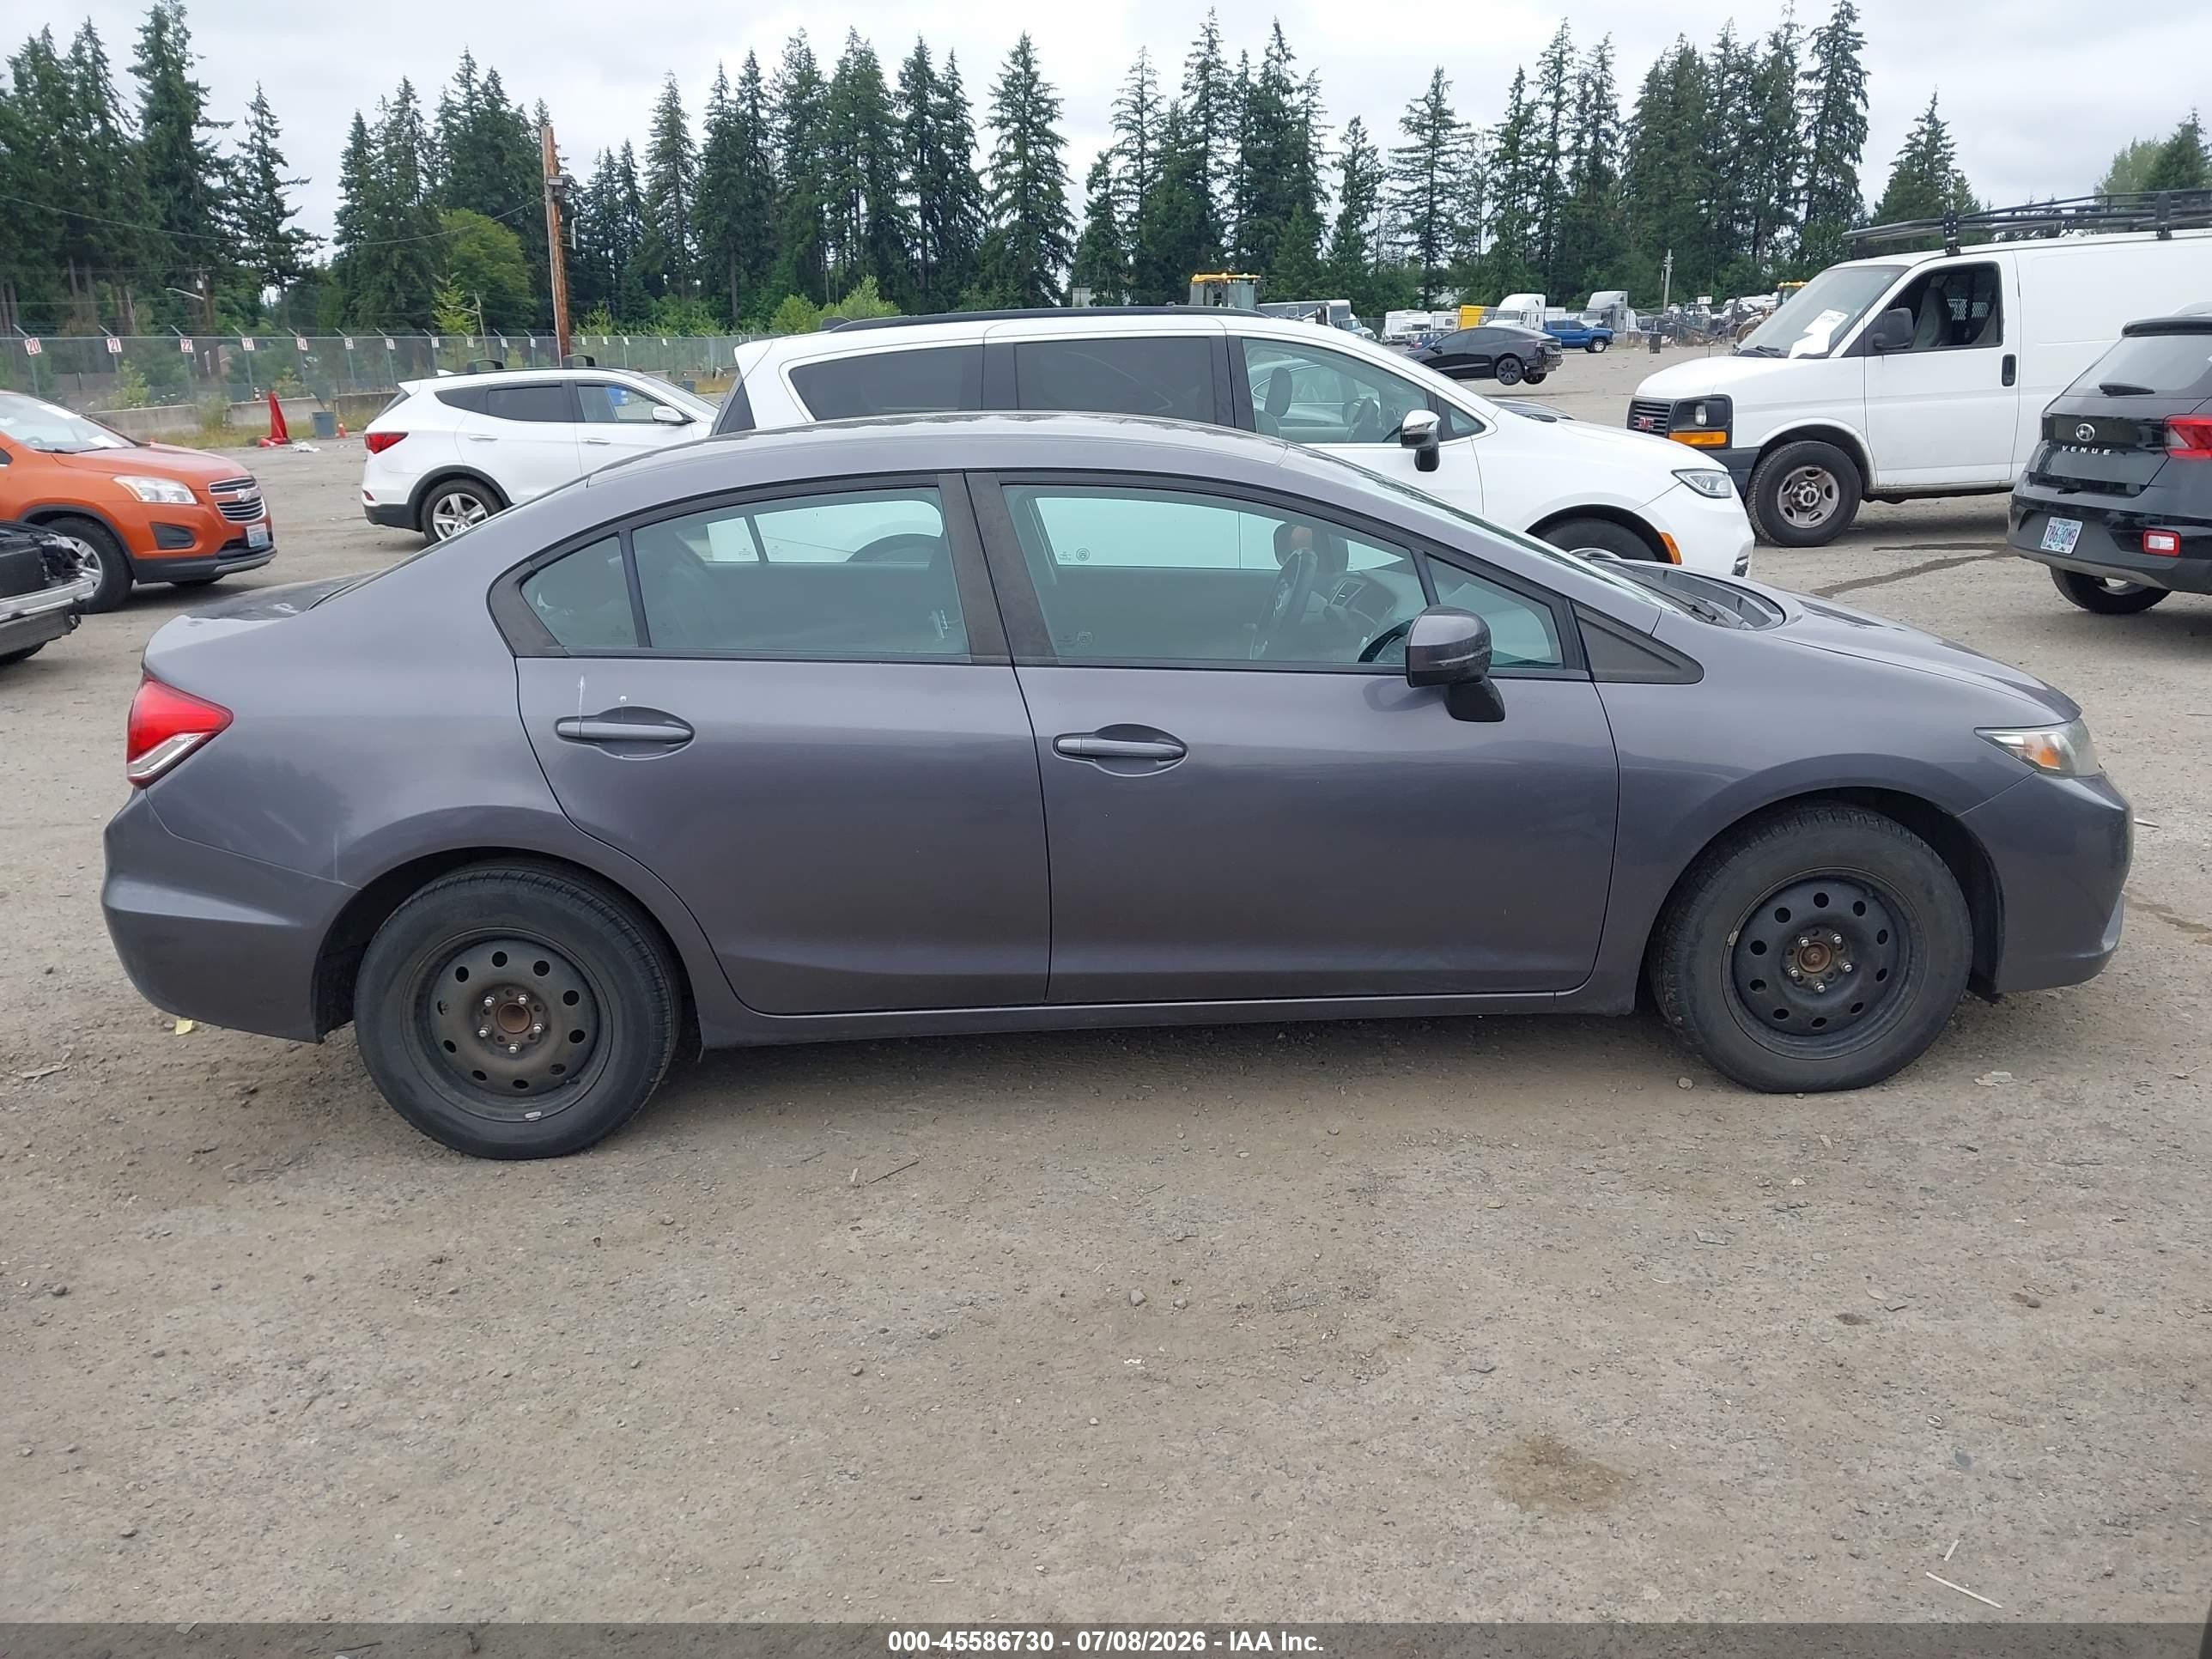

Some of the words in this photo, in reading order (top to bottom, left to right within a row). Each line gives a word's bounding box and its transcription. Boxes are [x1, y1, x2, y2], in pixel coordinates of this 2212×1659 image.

[27, 338, 40, 353] 20
[109, 338, 119, 352] 21
[181, 338, 192, 352] 22
[2062, 445, 2112, 456] VENUE
